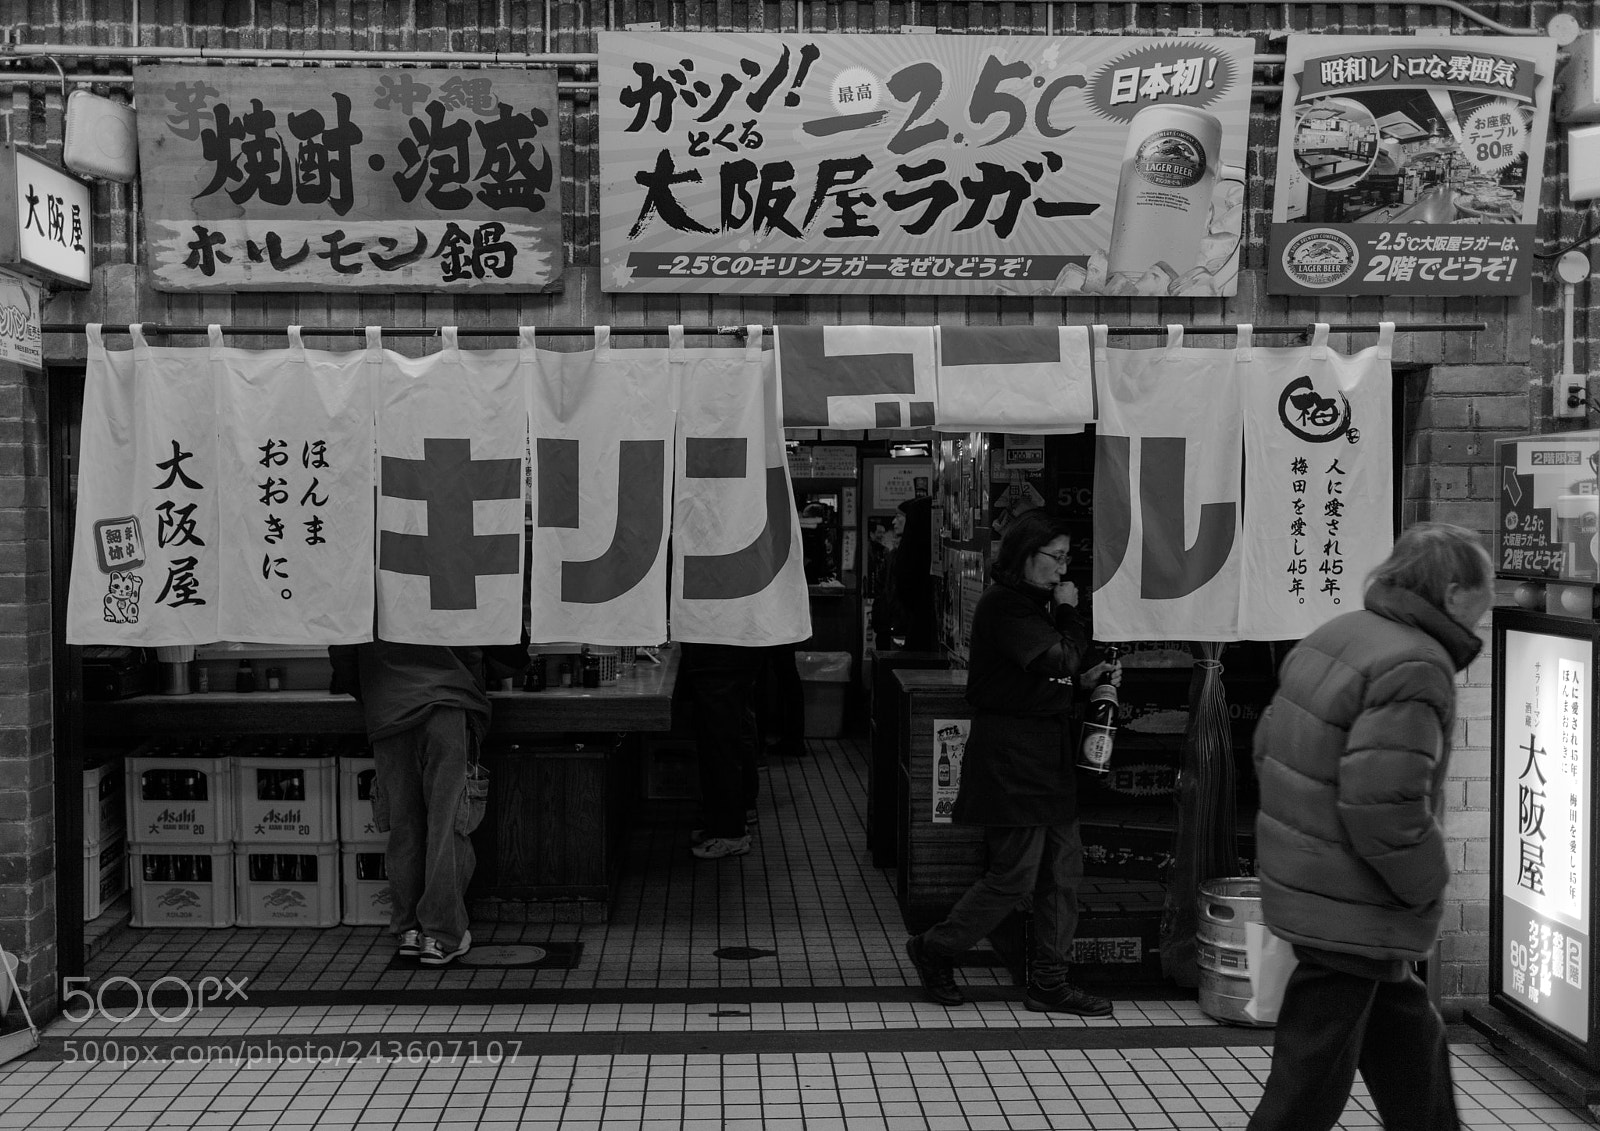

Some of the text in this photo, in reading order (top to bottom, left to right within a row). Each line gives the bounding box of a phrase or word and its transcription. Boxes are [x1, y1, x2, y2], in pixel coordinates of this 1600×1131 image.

[1110, 56, 1217, 106] 日本初!
[1320, 53, 1517, 87] 昭和レトロな雰囲気
[374, 74, 497, 116] 沖縄
[837, 83, 873, 103] 最高
[1474, 112, 1512, 130] お座敷
[687, 118, 763, 157] とくる
[1469, 126, 1519, 145] テーブル
[1476, 140, 1514, 162] 80席
[1145, 163, 1194, 177] LAGER BEER
[627, 150, 1101, 240] 大阪屋ラガー
[25, 183, 86, 255] 大阪屋
[183, 222, 518, 283] ホルモン鍋
[1298, 264, 1341, 272] LAGER BEER
[1363, 254, 1517, 282] 2階でどうぞ!
[1533, 452, 1580, 465] 2階限定
[300, 440, 330, 545] ほんま
[152, 440, 206, 608] 大阪屋
[257, 438, 293, 600] おおきに。
[1287, 456, 1309, 606] 梅田を愛し45年。
[1319, 458, 1346, 606] 人に愛され45年。
[1502, 548, 1567, 572] 2階でどうぞ!
[157, 808, 196, 823] Asahi
[262, 808, 301, 823] Asahi
[1517, 732, 1548, 897] 大阪屋
[149, 823, 160, 835] 大
[193, 824, 205, 835] 20
[254, 823, 266, 835] 大
[298, 824, 310, 835] 20
[364, 823, 375, 834] 大
